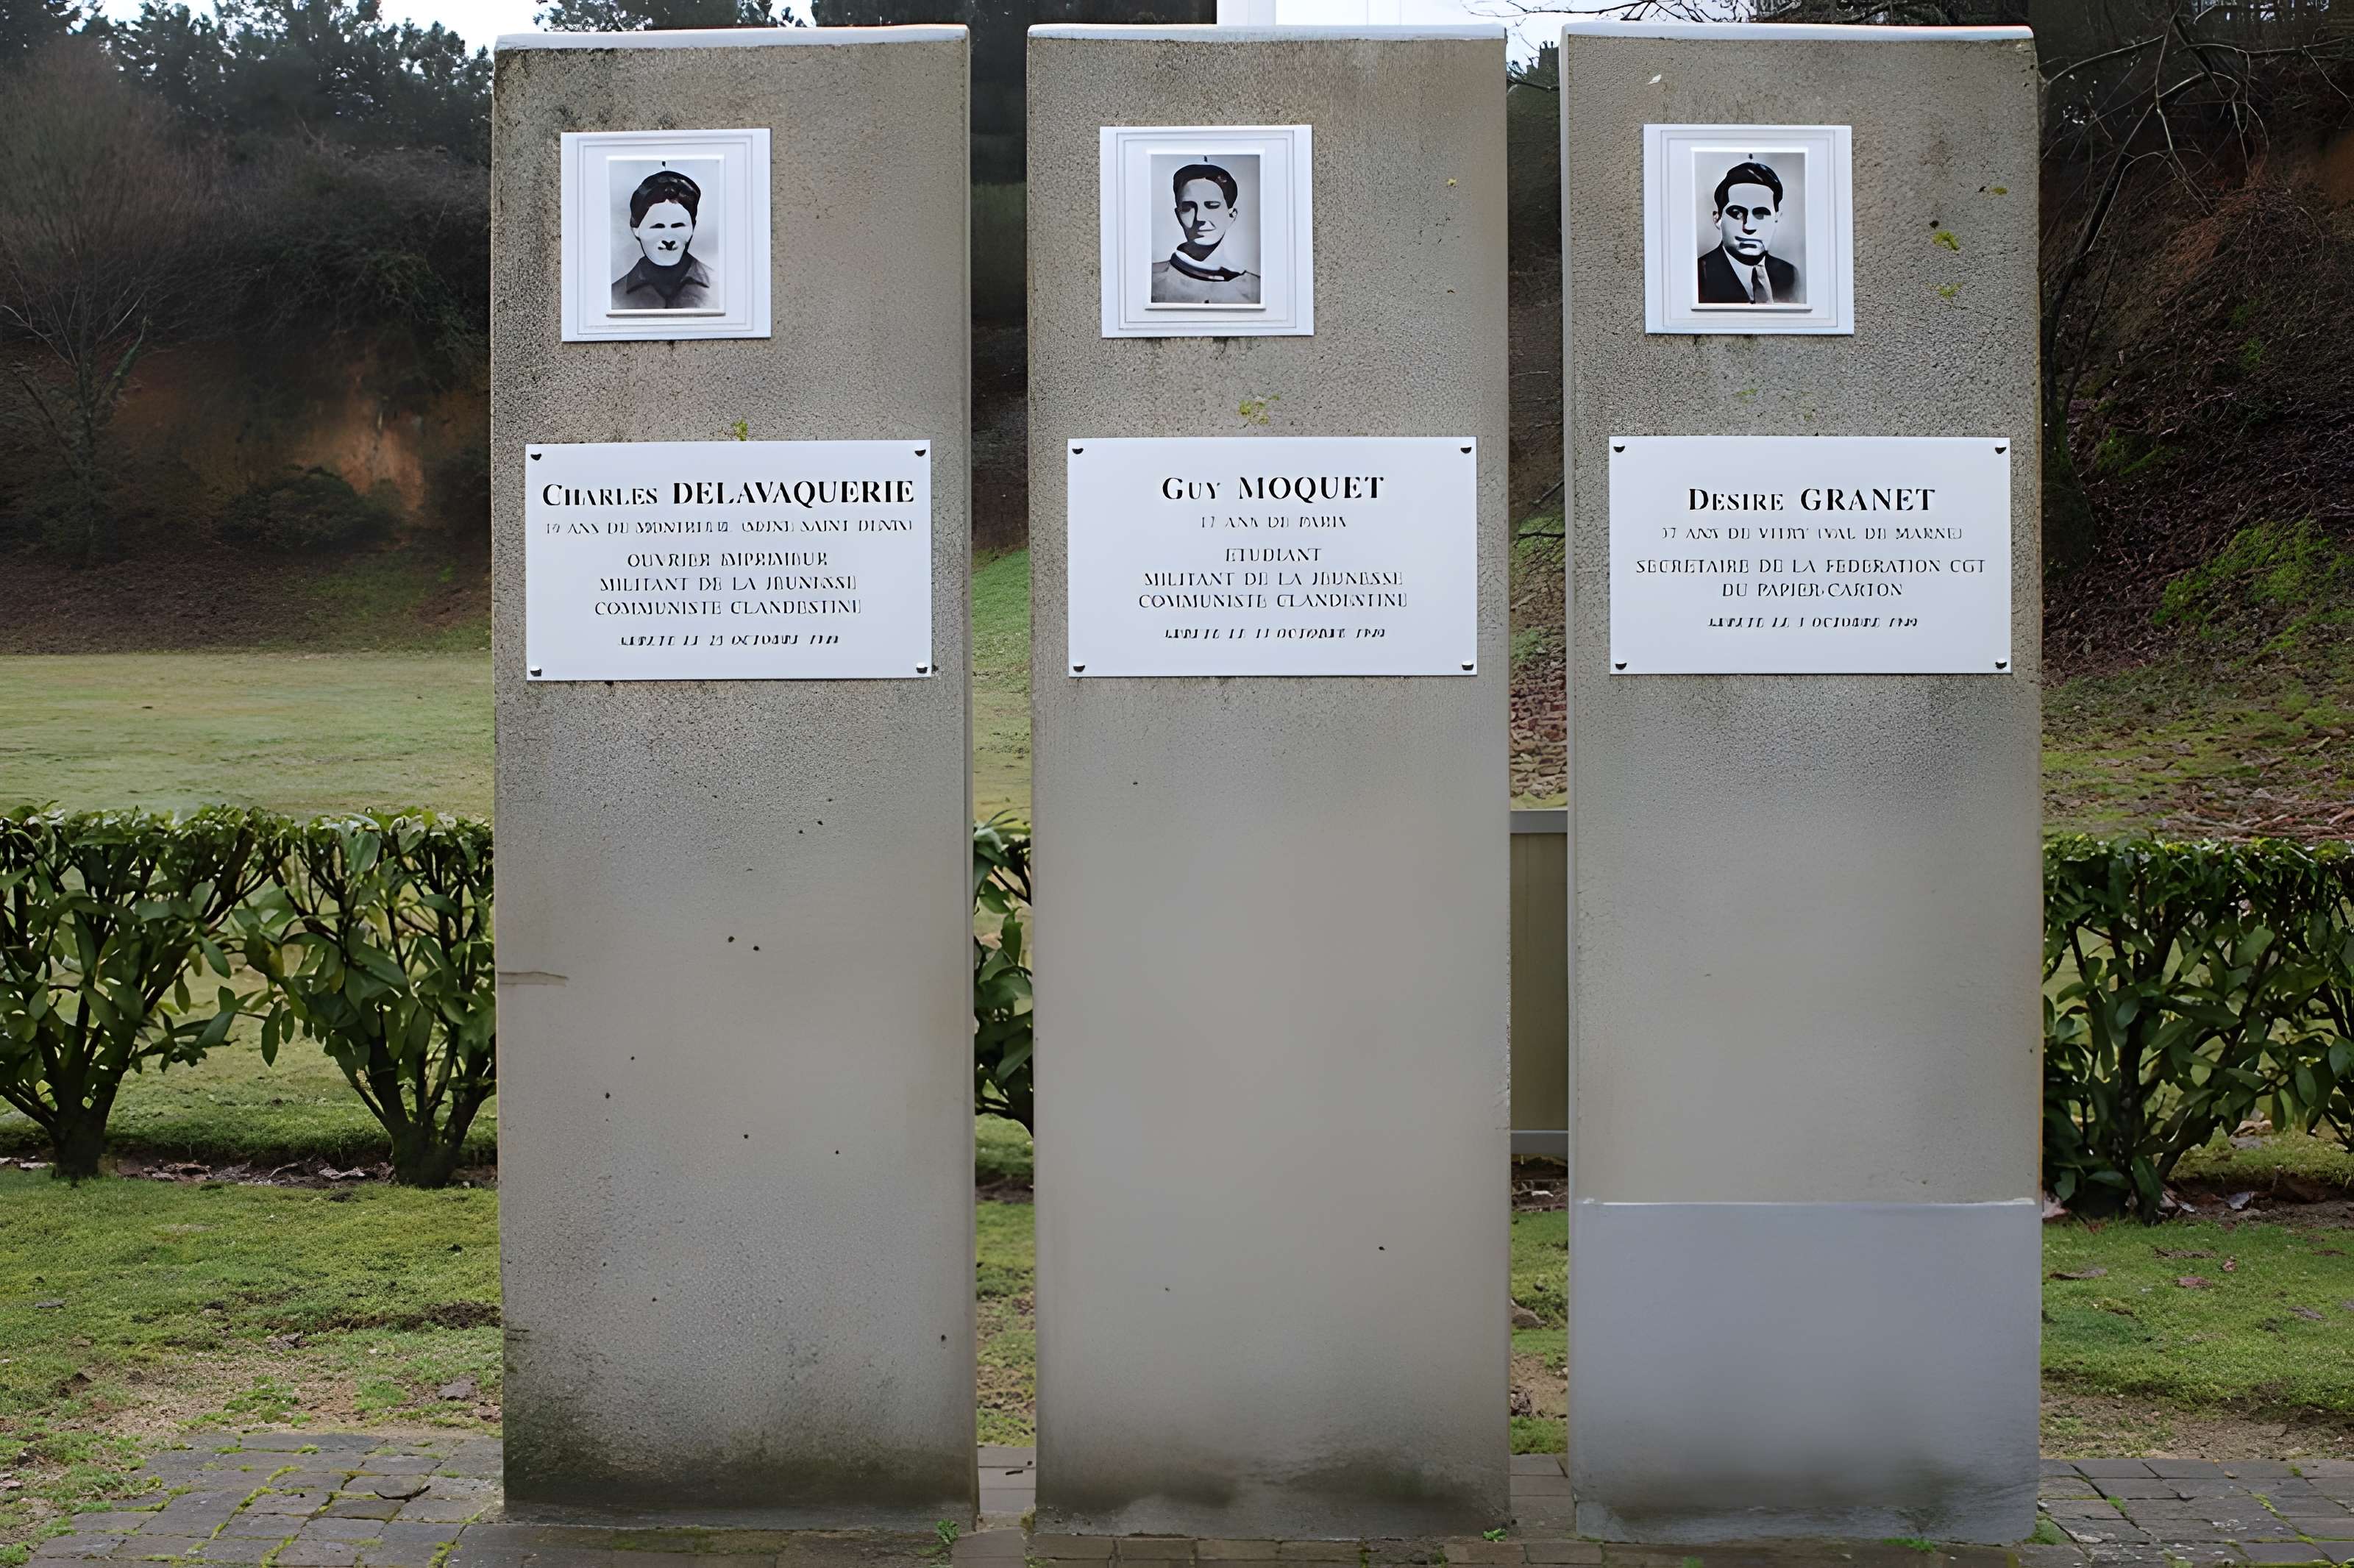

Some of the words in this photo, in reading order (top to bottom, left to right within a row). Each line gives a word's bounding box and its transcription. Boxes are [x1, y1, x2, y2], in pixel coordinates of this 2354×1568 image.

[673, 480, 914, 509] DELAVAQUERIE
[1239, 476, 1384, 504] MOQUET
[1800, 488, 1936, 511] GRANET
[1201, 516, 1215, 528] 17
[627, 552, 710, 568] OUVRIER
[1226, 548, 1322, 562] ETUDIANT
[1635, 559, 1749, 574] SECRETAIRE
[1759, 558, 1783, 573] DE
[1792, 559, 1816, 574] LA
[1826, 559, 1941, 574] FEDERATION
[1949, 559, 1986, 574] CGT
[600, 577, 689, 592] MILITANT
[699, 577, 722, 591] DE
[733, 576, 756, 591] LA
[766, 575, 856, 591] JEUNESSE
[1145, 571, 1236, 587] MILITANT
[1245, 571, 1268, 586] DE
[1279, 571, 1302, 585] LA
[1312, 571, 1403, 586] JEUNESSE
[1722, 582, 1748, 597] DU
[594, 601, 722, 616] COMMUNISTE
[730, 599, 861, 615] CLANDESTINE
[1139, 594, 1267, 608] COMMUNISTE
[1276, 593, 1407, 607] CLANDESTINE
